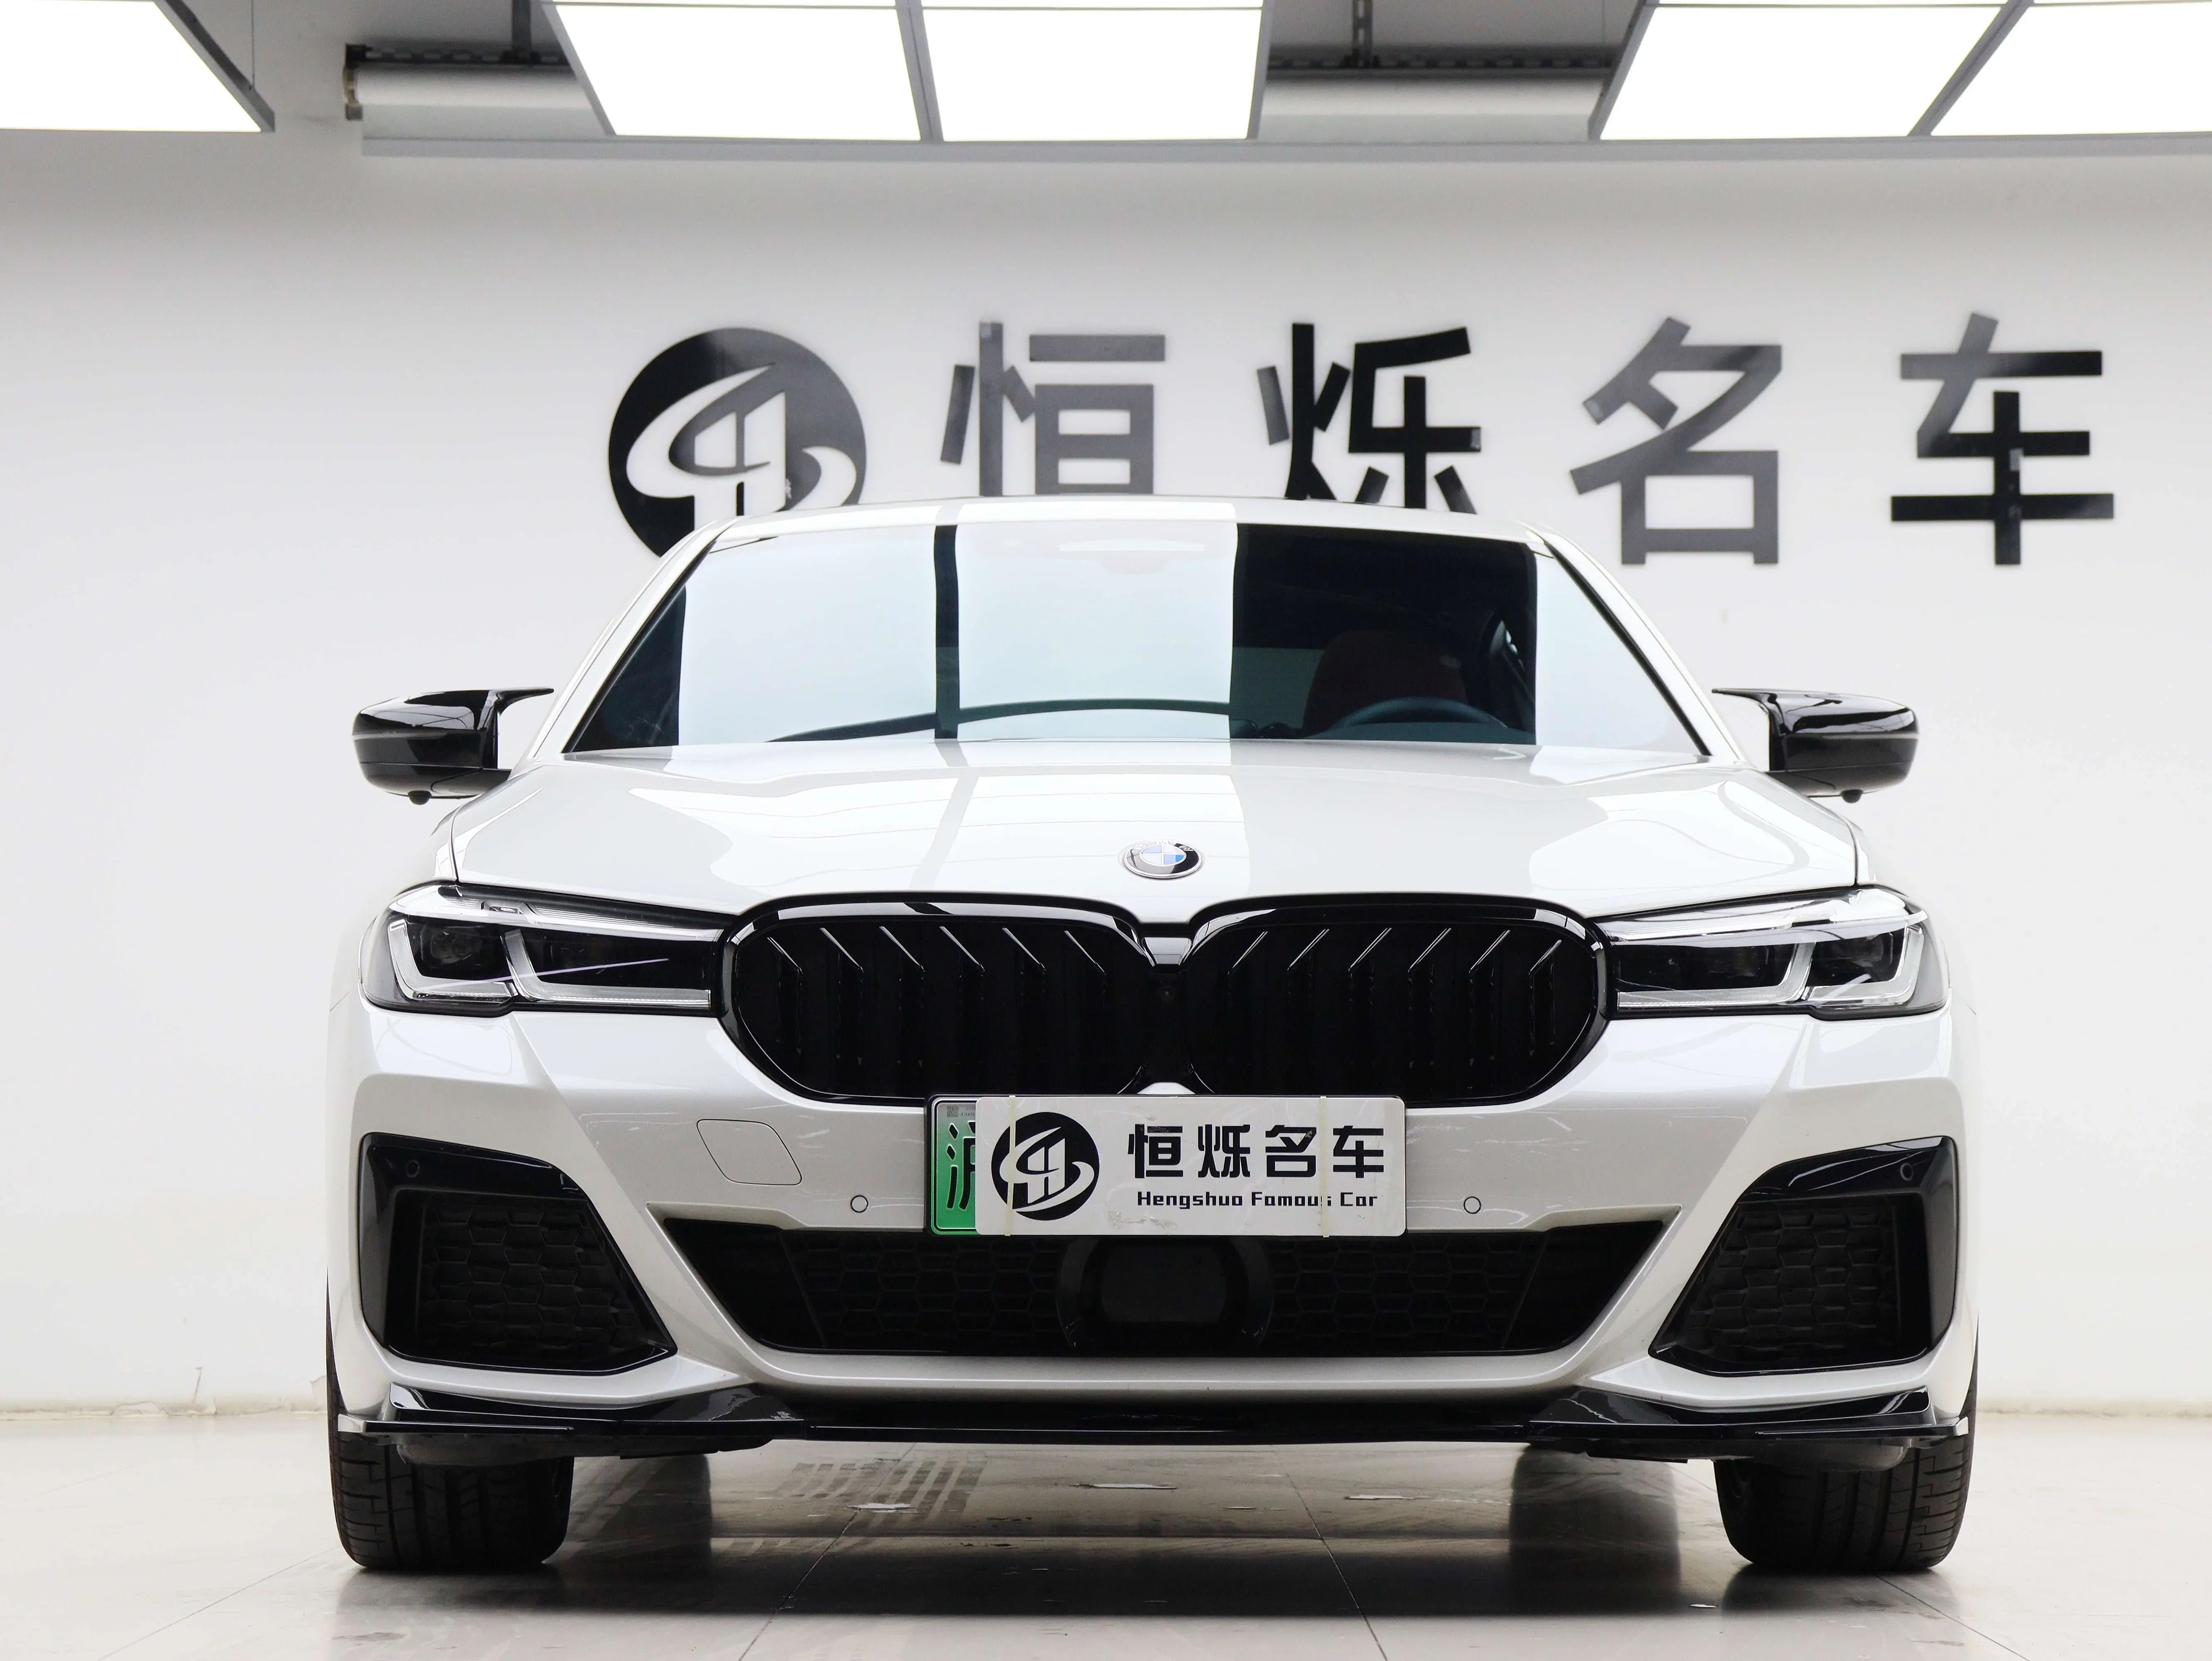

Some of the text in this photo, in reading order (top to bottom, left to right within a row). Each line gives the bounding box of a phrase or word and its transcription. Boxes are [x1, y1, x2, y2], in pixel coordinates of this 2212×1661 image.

[940, 314, 2114, 566] 恒烁名车
[1133, 840, 1194, 852] BMW
[1128, 1124, 1384, 1178] 恒烁名车
[1138, 1191, 1243, 1210] Hengshuo
[1340, 1192, 1378, 1206] Car
